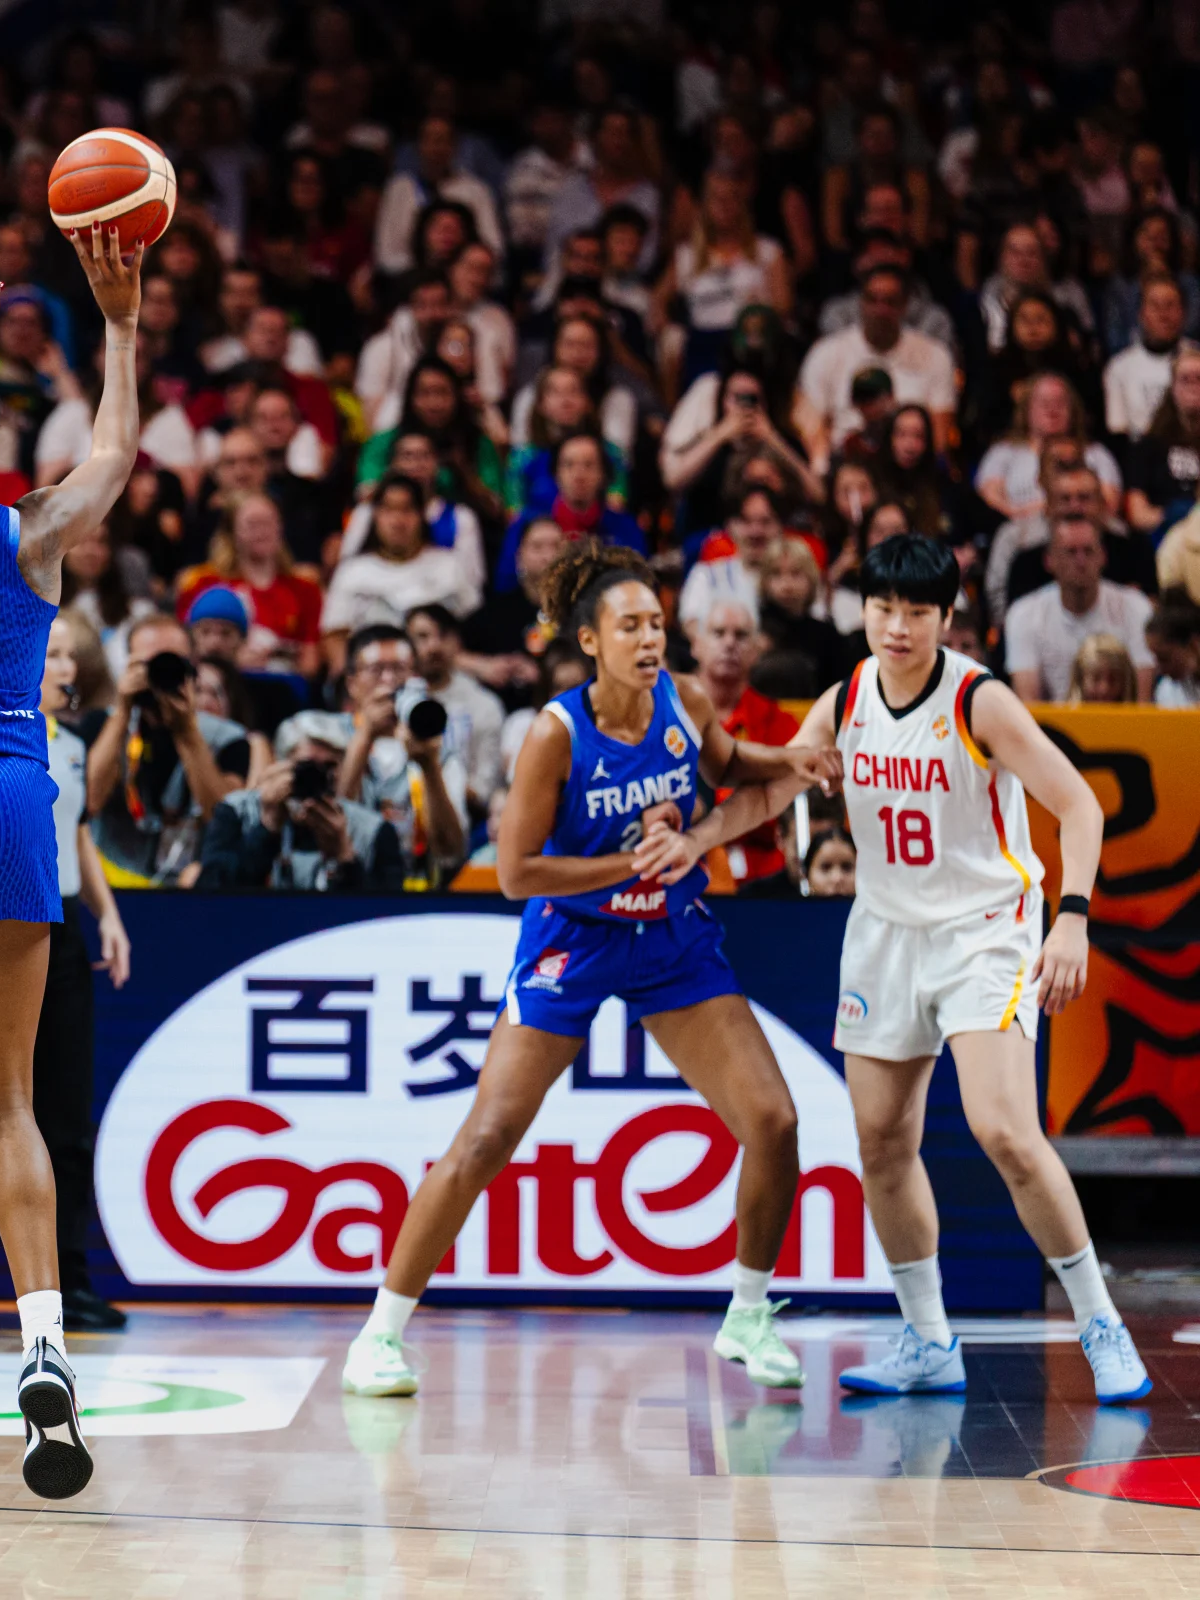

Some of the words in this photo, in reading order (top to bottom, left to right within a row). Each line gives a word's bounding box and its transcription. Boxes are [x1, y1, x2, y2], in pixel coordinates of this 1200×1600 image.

[586, 763, 692, 819] FRANCE
[853, 752, 950, 792] CHINA
[878, 806, 934, 866] 18
[611, 890, 666, 911] MAIF
